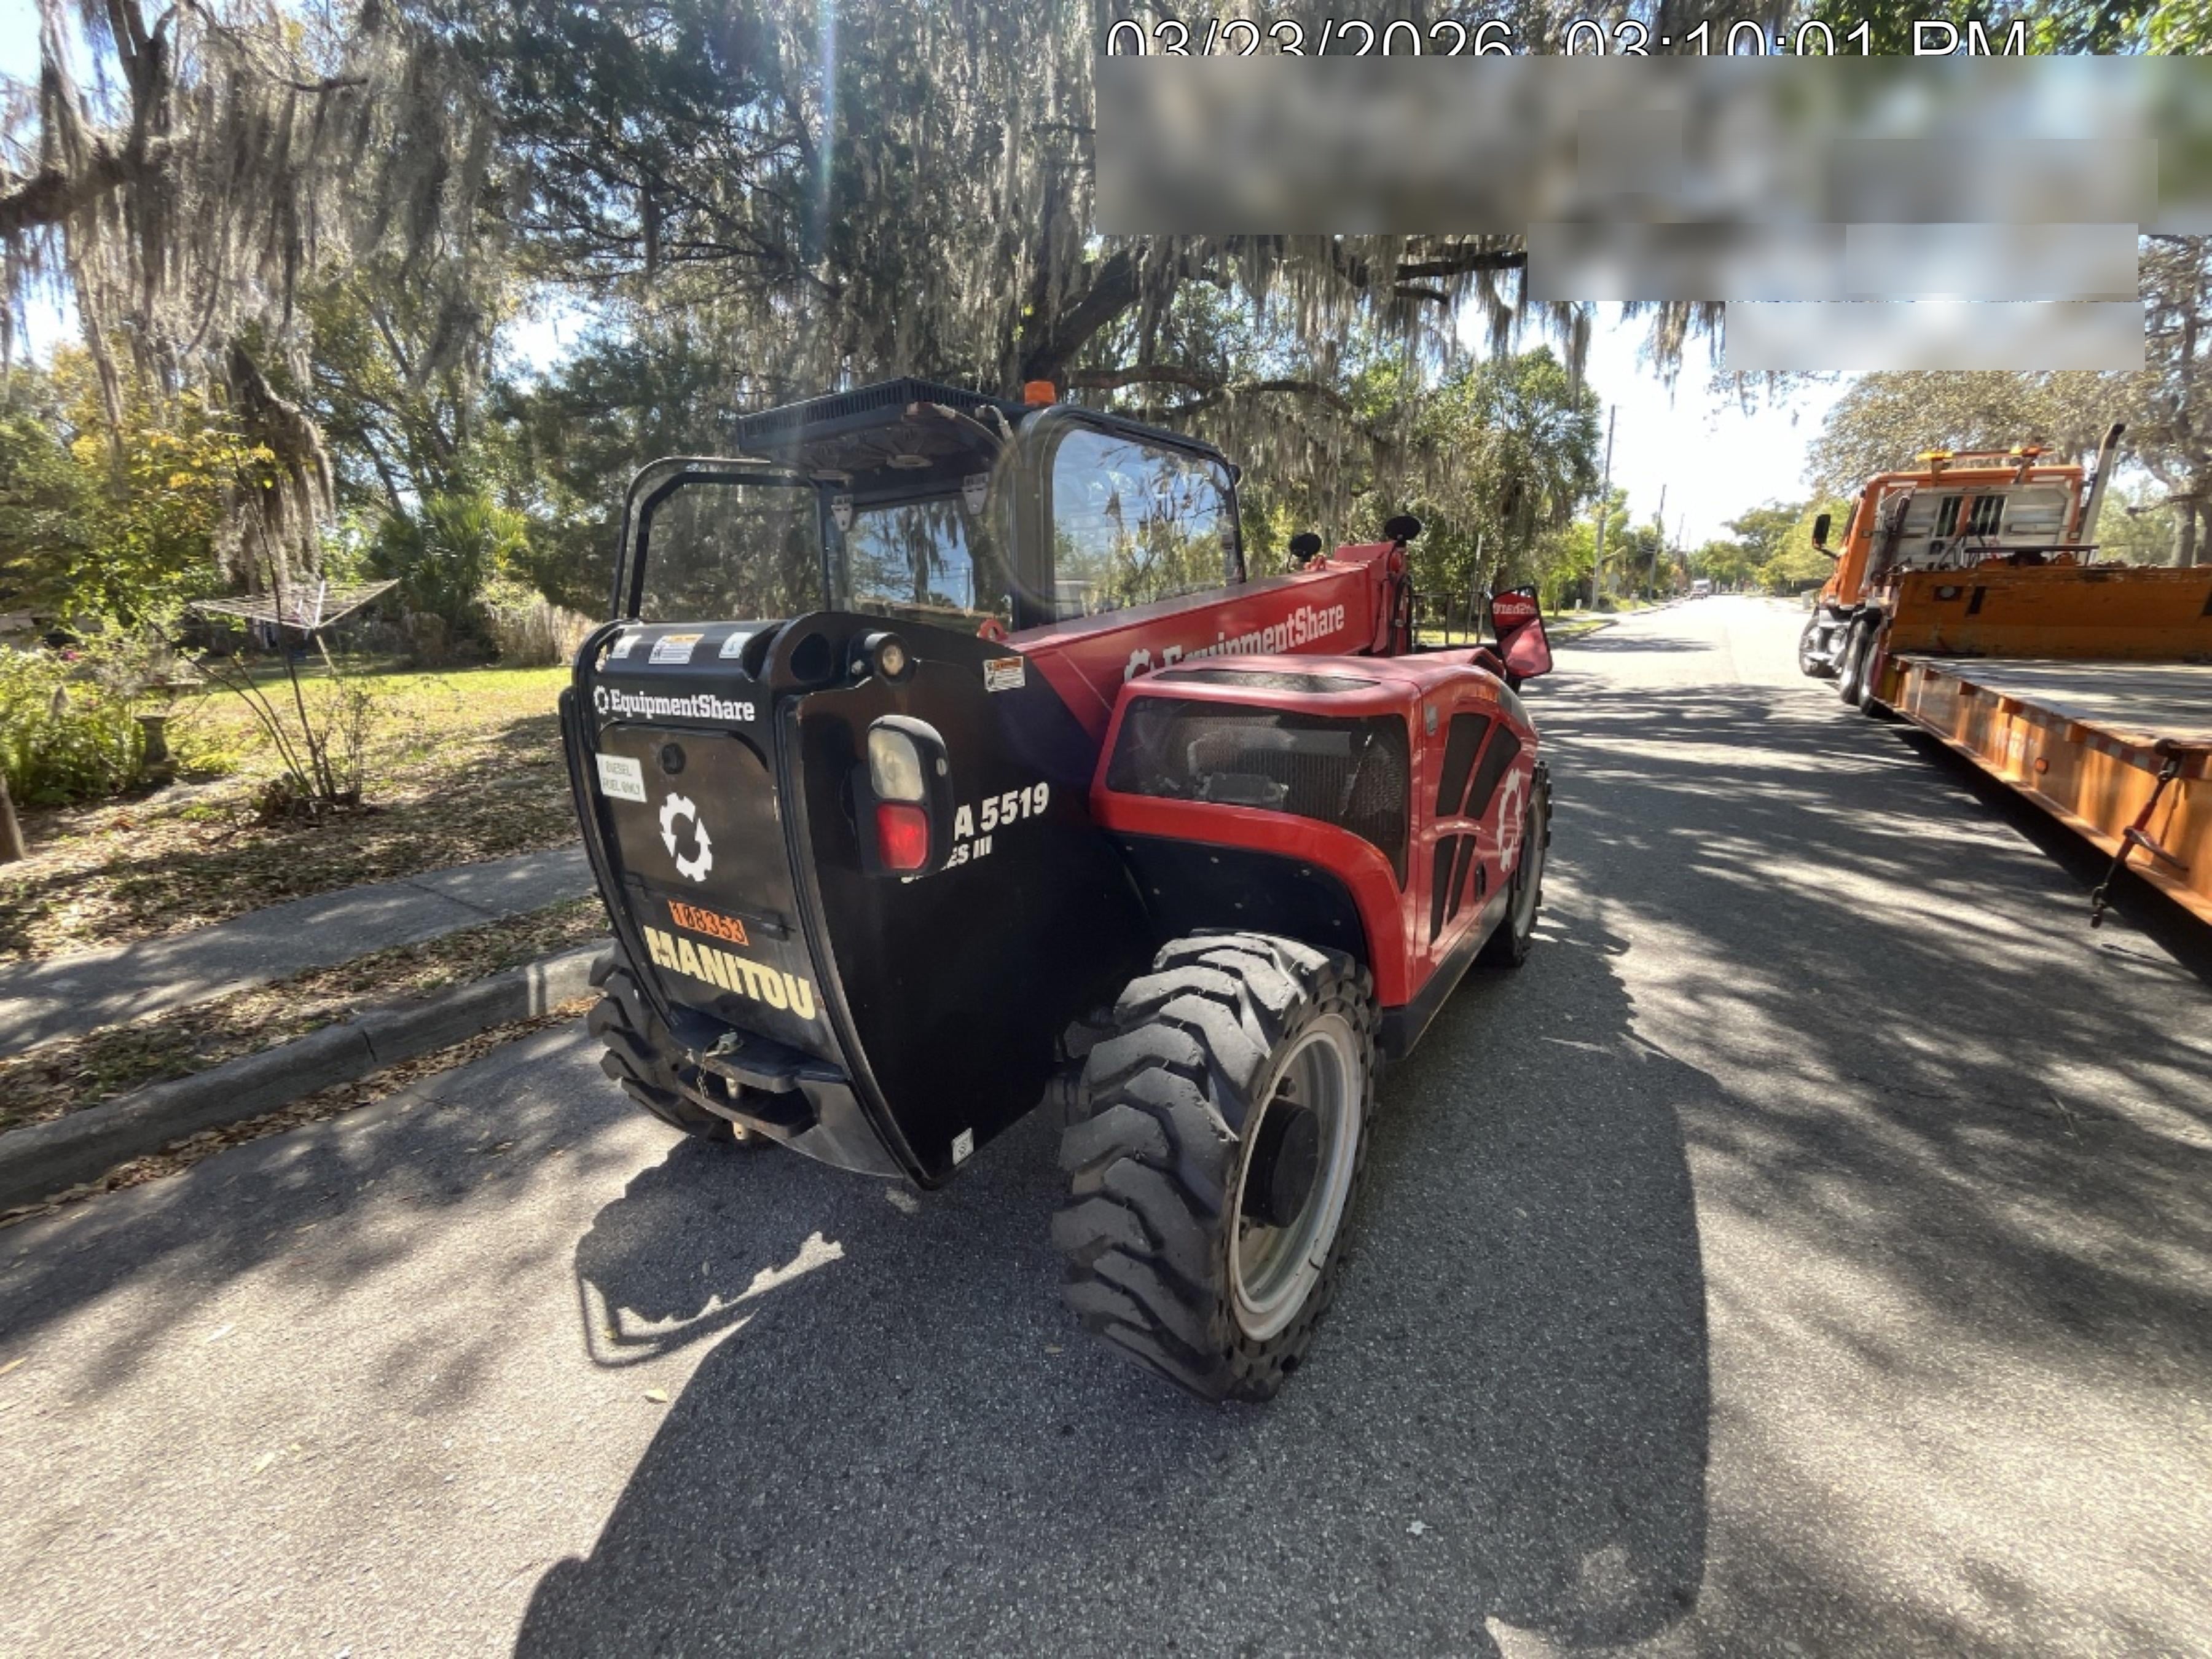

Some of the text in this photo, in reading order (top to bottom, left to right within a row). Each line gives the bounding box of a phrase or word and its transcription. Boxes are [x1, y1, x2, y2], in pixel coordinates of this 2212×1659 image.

[1163, 604, 1344, 665] ipmentShare
[611, 689, 755, 721] EquipmentShare
[980, 782, 1049, 832] 5519
[643, 926, 815, 1020] MANITOU
